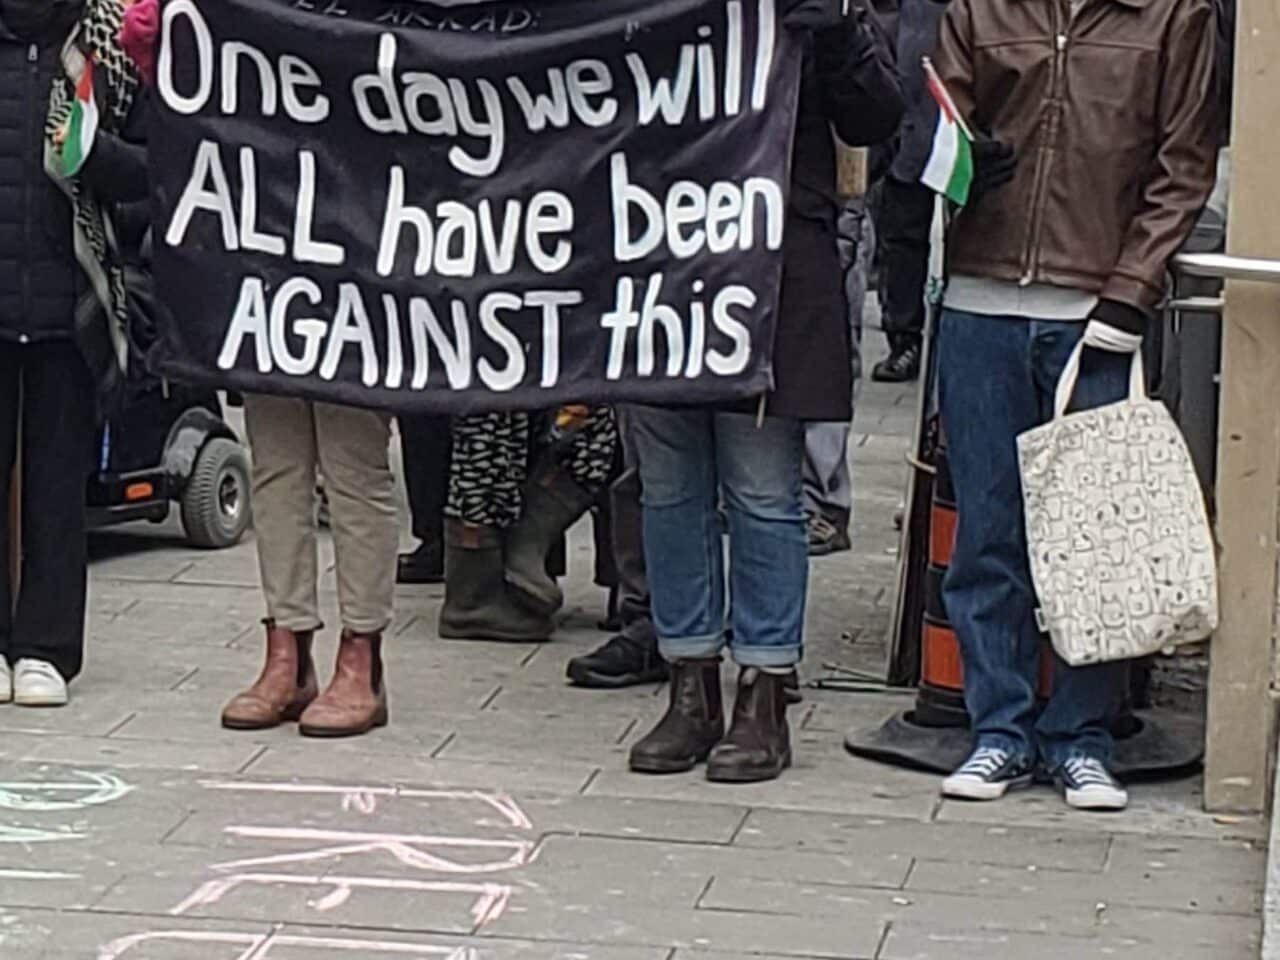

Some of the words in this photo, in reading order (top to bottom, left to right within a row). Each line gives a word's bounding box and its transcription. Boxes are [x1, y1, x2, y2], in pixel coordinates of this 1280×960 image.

[353, 32, 503, 176] day
[507, 59, 618, 131] we
[166, 141, 345, 264] ALL
[376, 166, 574, 277] have
[611, 153, 784, 261] been
[218, 277, 583, 392] AGAINST
[600, 272, 757, 380] this
